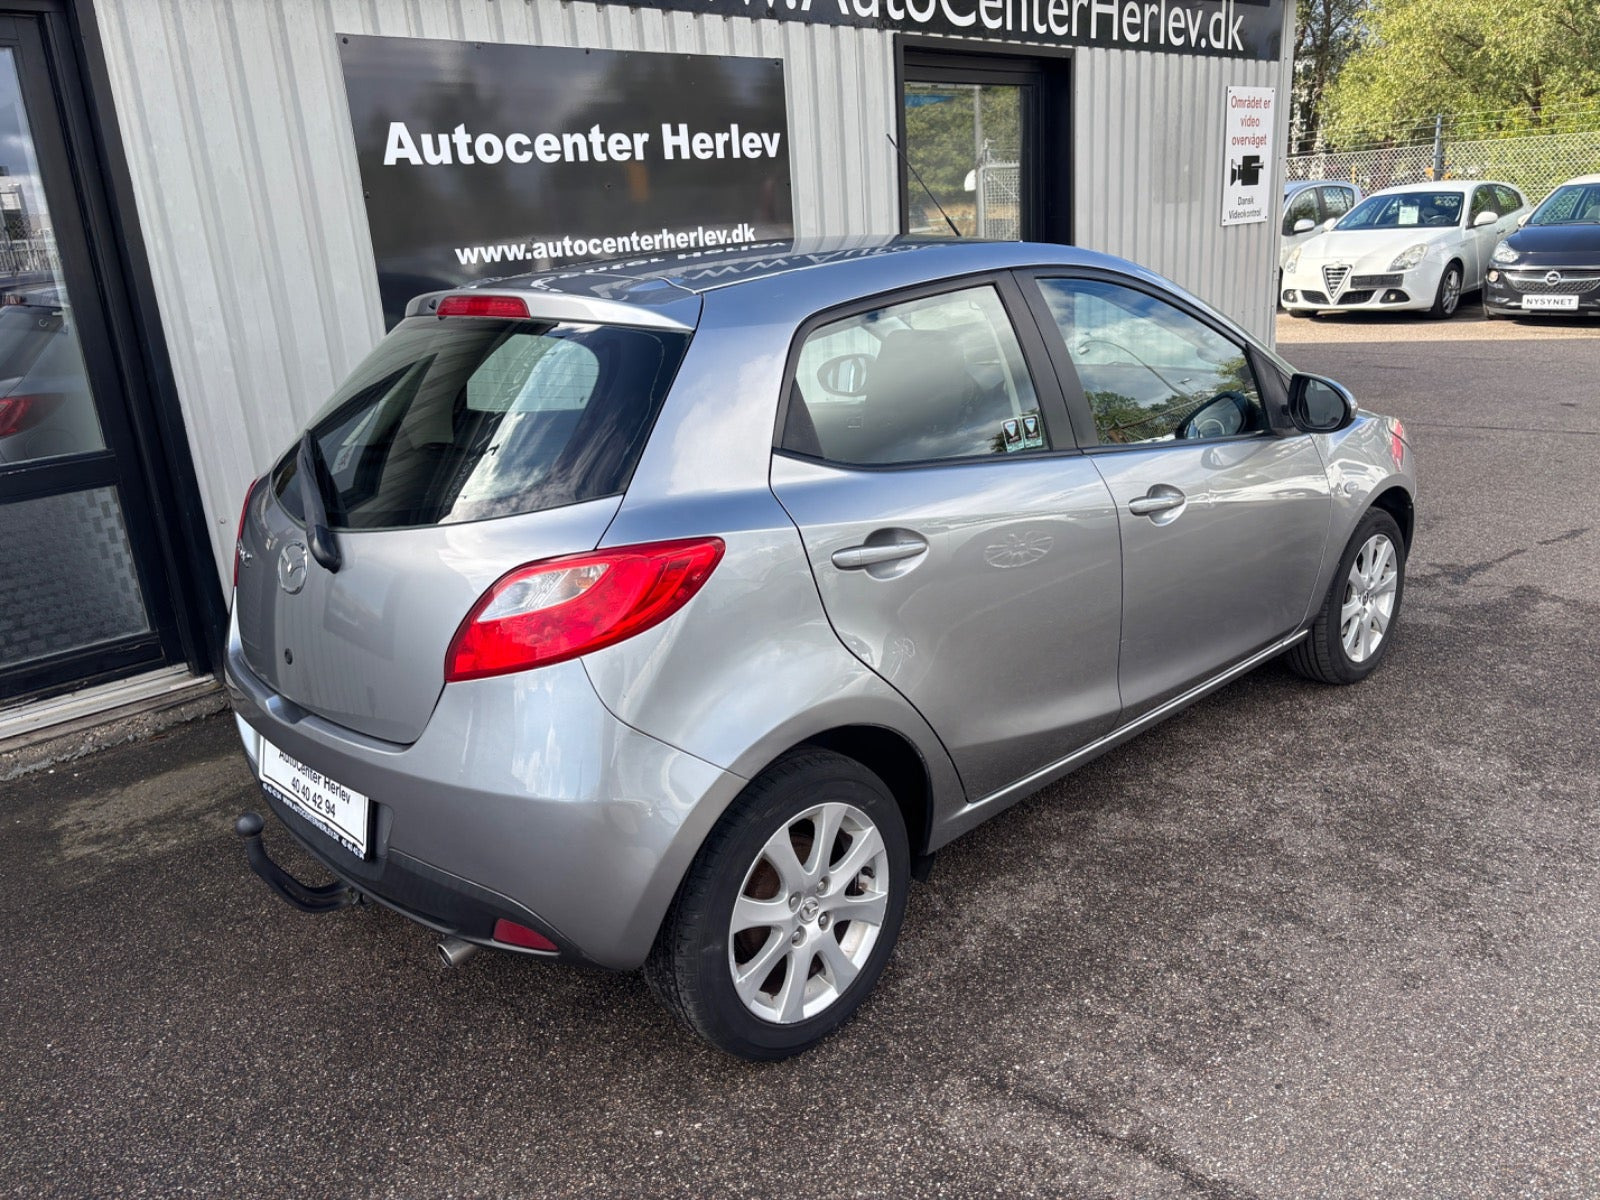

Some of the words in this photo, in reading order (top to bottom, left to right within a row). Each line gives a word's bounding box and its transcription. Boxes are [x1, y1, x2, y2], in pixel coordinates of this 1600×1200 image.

[1231, 95, 1262, 109] Området
[1263, 99, 1271, 109] er
[1240, 115, 1260, 127] video
[383, 122, 649, 166] Autocenter
[662, 123, 782, 160] Herlev
[1232, 133, 1267, 148] overvåget
[455, 223, 756, 266] www.autocenterherlev.dk
[1526, 298, 1573, 306] NYSYNET
[291, 776, 301, 793] 40
[301, 784, 310, 801] 40
[312, 792, 324, 810] 42
[325, 799, 337, 818] 94
[324, 775, 351, 804] Herlev
